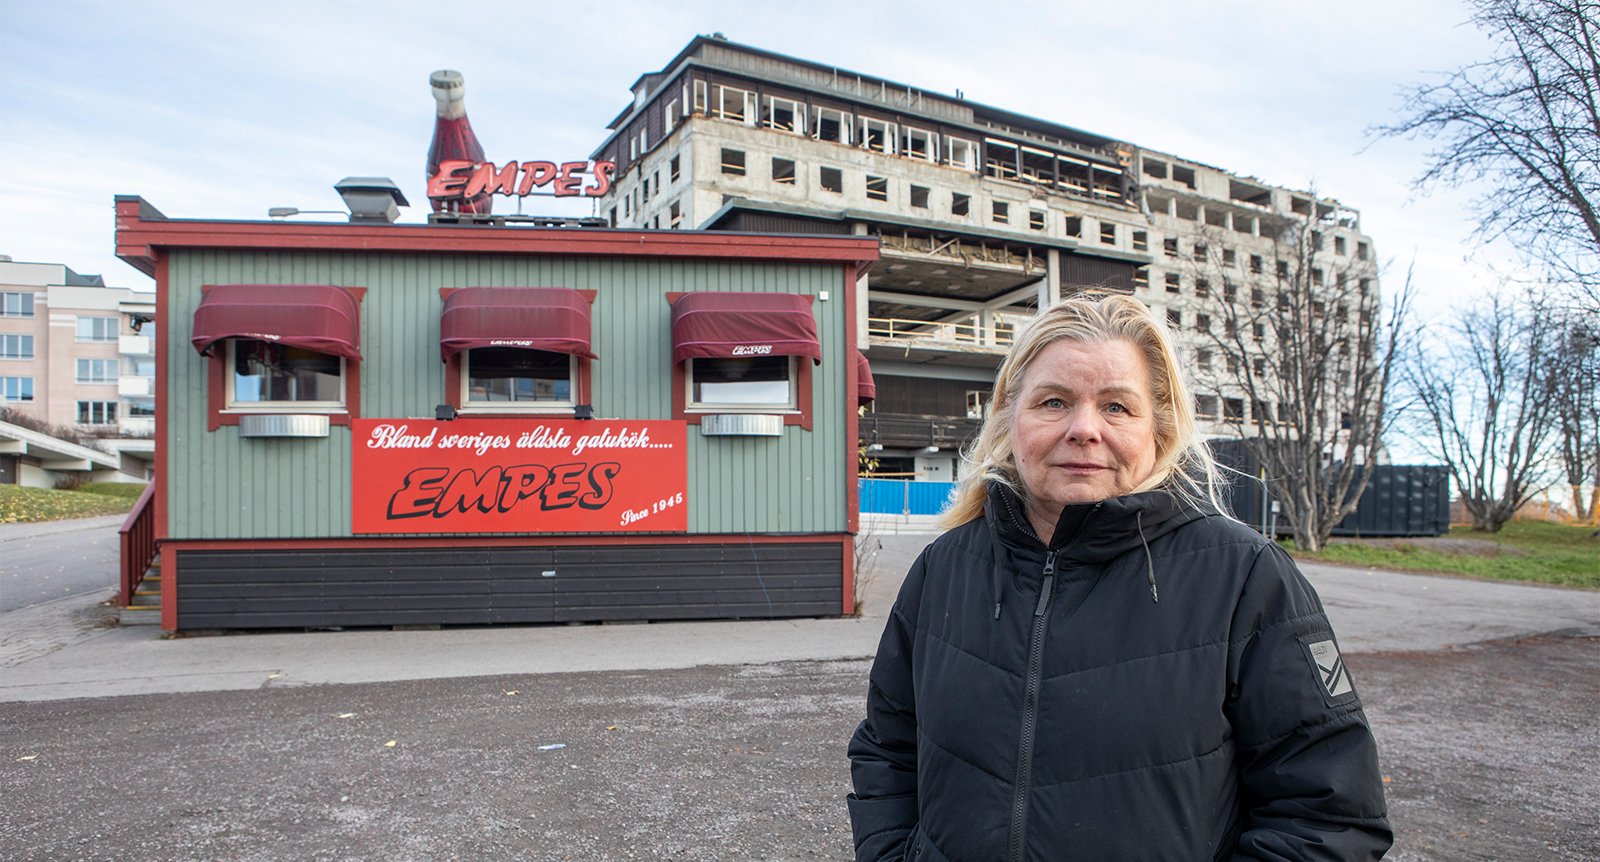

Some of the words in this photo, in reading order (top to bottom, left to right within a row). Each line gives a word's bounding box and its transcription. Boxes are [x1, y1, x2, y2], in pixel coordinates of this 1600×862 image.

[427, 159, 615, 198] EMPES
[367, 424, 438, 449] Bland
[437, 431, 511, 456] sveriges
[516, 425, 572, 449] äldsta
[573, 427, 673, 455] gatukök.....
[386, 462, 621, 520] EMPES
[620, 509, 649, 526] Since
[652, 492, 683, 514] 1945
